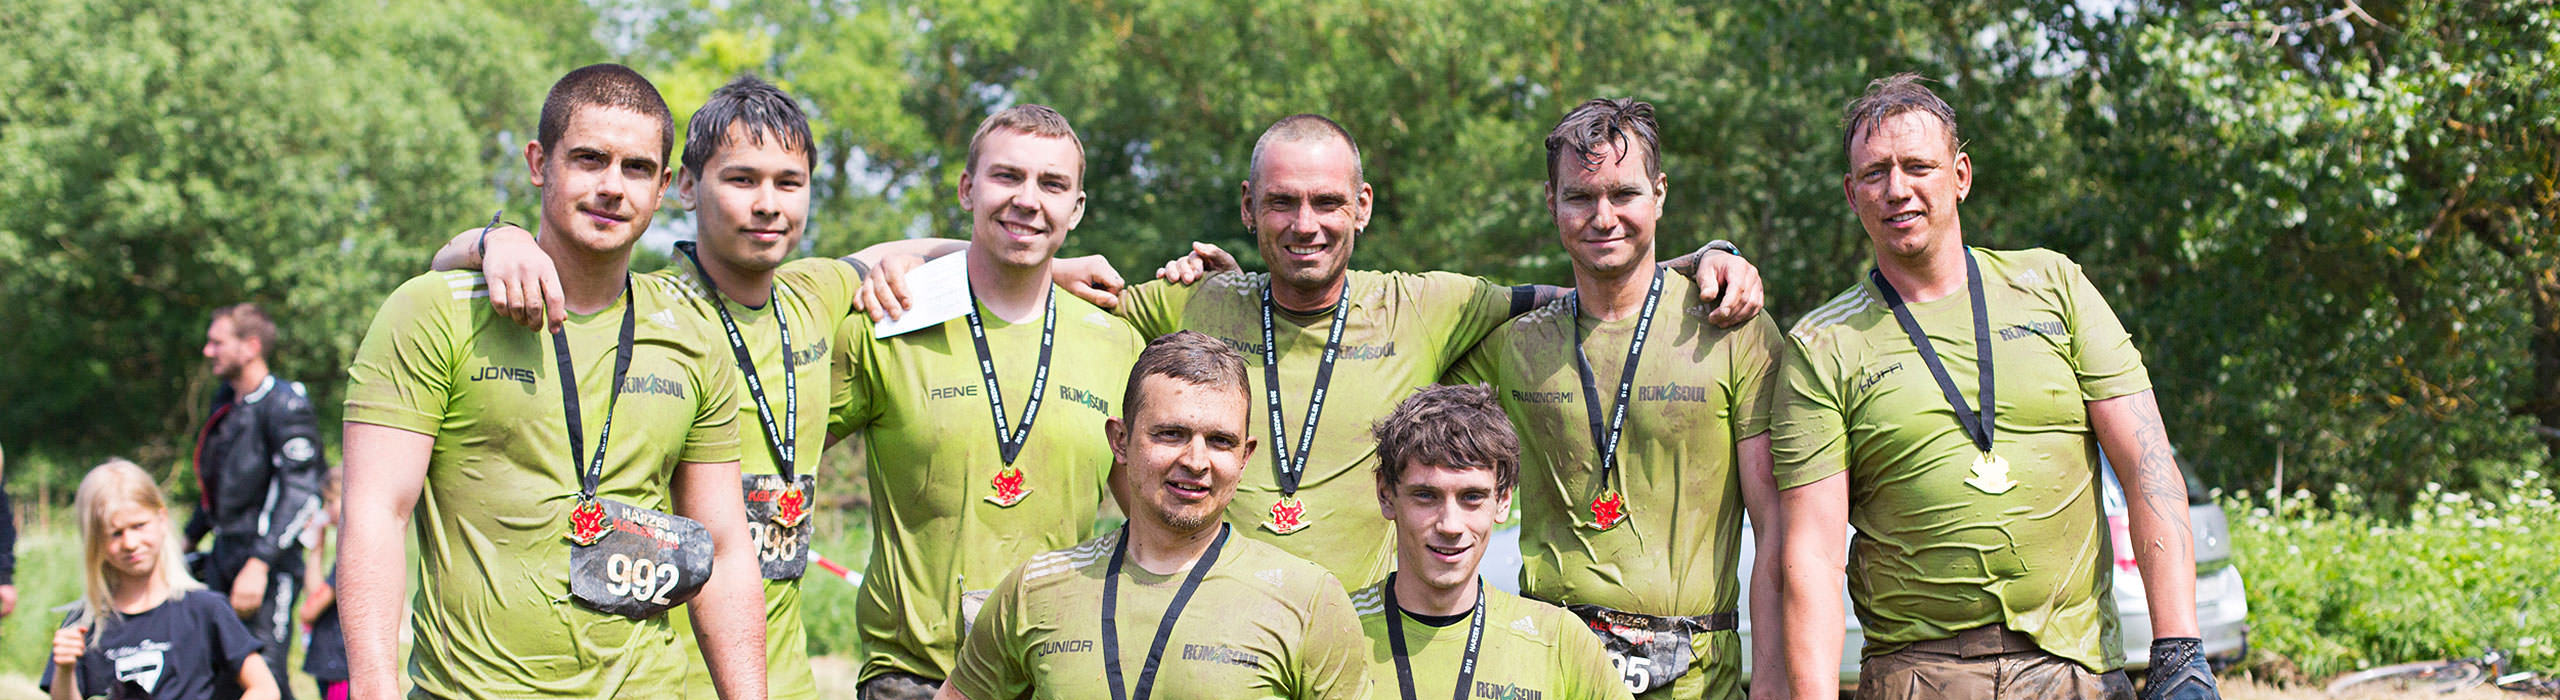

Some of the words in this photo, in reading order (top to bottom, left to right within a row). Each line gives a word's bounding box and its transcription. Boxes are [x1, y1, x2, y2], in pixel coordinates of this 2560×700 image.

[1337, 298, 1349, 320] KEILER
[1643, 294, 1657, 318] HARZER
[730, 332, 743, 348] RUN
[1331, 318, 1344, 344] HARZER
[1636, 317, 1649, 341] KEILER
[1266, 351, 1274, 365] RUN
[1631, 340, 1642, 355] RUN
[471, 366, 536, 384] JONES
[1037, 365, 1047, 379] RUN
[787, 388, 795, 412] KEILER
[931, 385, 978, 400] RENE
[1033, 379, 1044, 400] KEILER
[1059, 384, 1110, 417] RUN4SOUL
[1620, 382, 1629, 398] 2015
[1638, 381, 1707, 403] RUN4SOUL
[988, 378, 1000, 405] HARZER
[994, 404, 1006, 428] KEILER
[1000, 428, 1010, 443] RUN
[1024, 400, 1038, 425] HARZER
[1301, 425, 1314, 452] HARZER
[1308, 403, 1320, 426] KEILER
[1314, 388, 1324, 403] RUN
[1612, 404, 1625, 430] HARZER
[758, 395, 772, 423] HARZER
[768, 422, 781, 446] KEILER
[778, 445, 788, 460] RUN
[787, 412, 795, 440] HARZER
[1272, 410, 1282, 436] HARZER
[1276, 436, 1286, 459] KEILER
[1608, 431, 1619, 454] KEILER
[1280, 458, 1290, 473] RUN
[621, 507, 671, 532] HARZER
[606, 553, 680, 606] 992
[1474, 605, 1485, 627] KEILER
[1038, 640, 1093, 657] JUNIOR
[1468, 625, 1481, 653] HARZER
[1463, 658, 1474, 675] 2015
